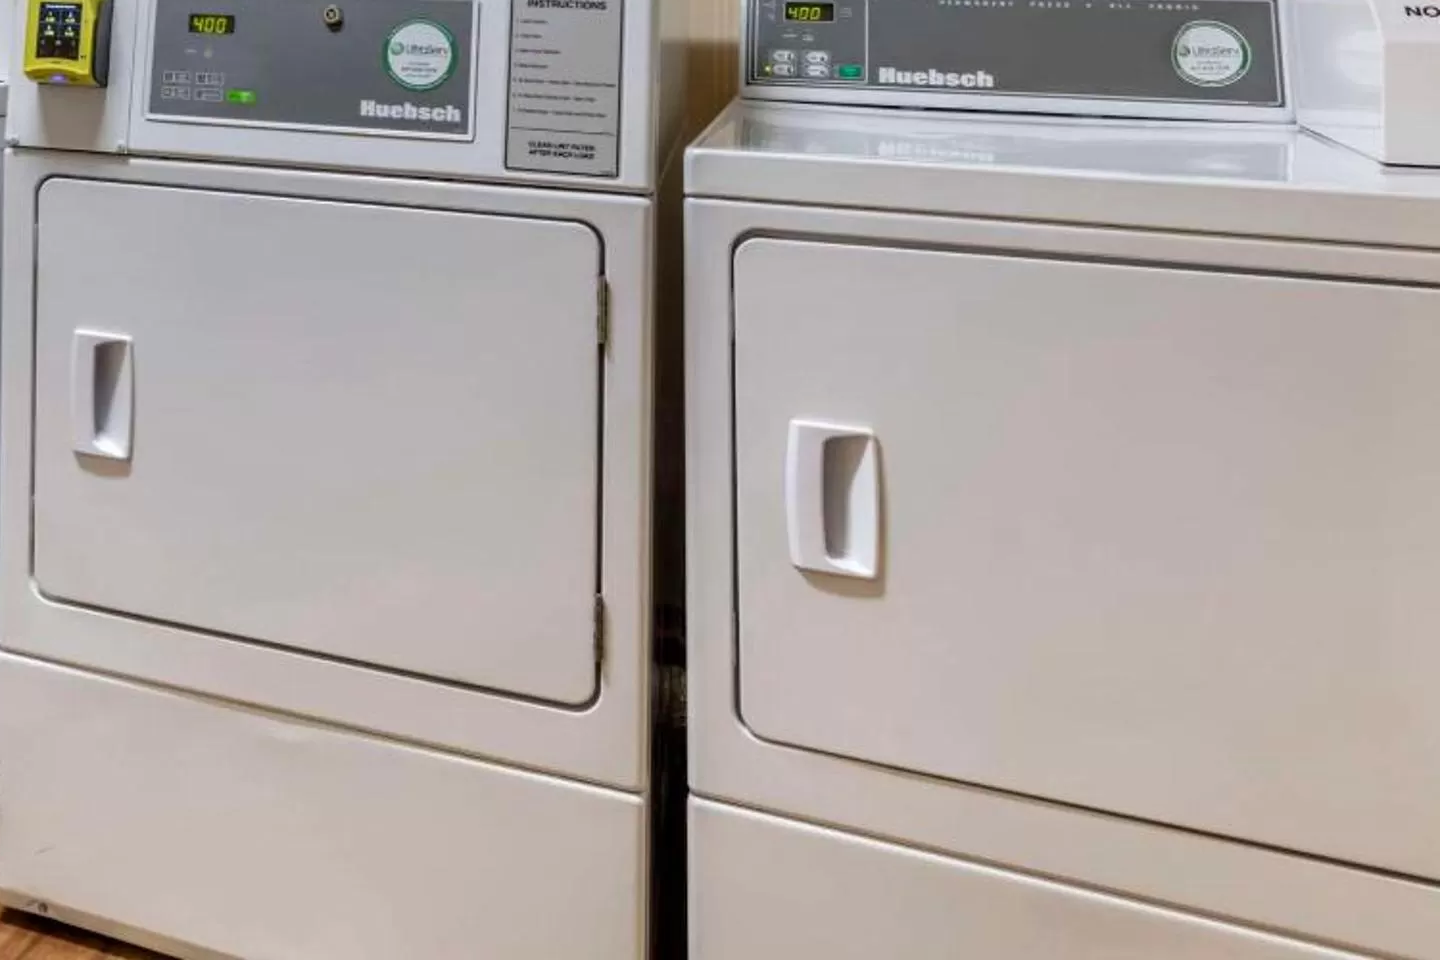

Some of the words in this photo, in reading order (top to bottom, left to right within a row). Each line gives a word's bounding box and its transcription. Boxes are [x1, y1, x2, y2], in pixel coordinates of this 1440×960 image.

[787, 7, 821, 21] 400
[1403, 5, 1440, 18] NO
[193, 16, 228, 34] 400
[879, 66, 994, 88] Huebsch
[360, 99, 461, 122] Huebsch
